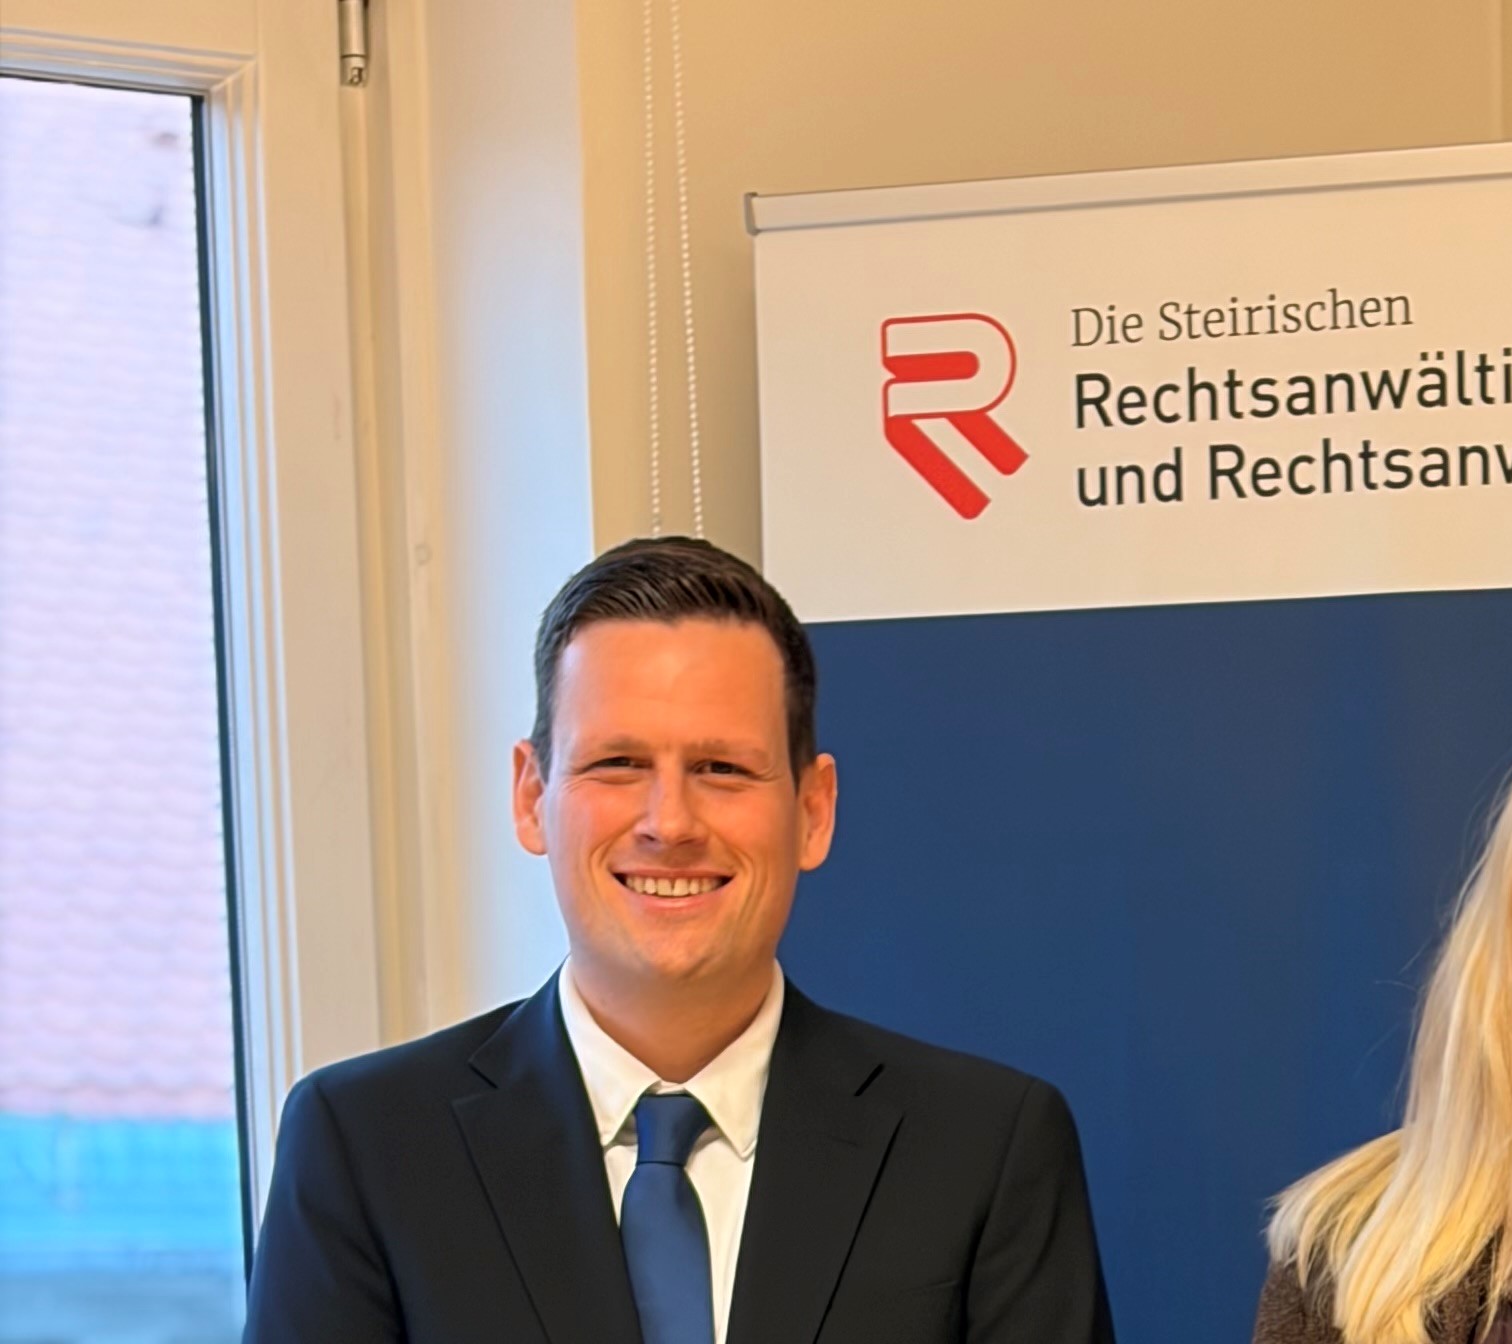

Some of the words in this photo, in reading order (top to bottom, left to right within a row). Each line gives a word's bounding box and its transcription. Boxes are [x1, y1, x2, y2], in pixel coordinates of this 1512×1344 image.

[1071, 305, 1143, 347] Die
[1159, 288, 1414, 342] Steirischen
[1077, 446, 1184, 507] und
